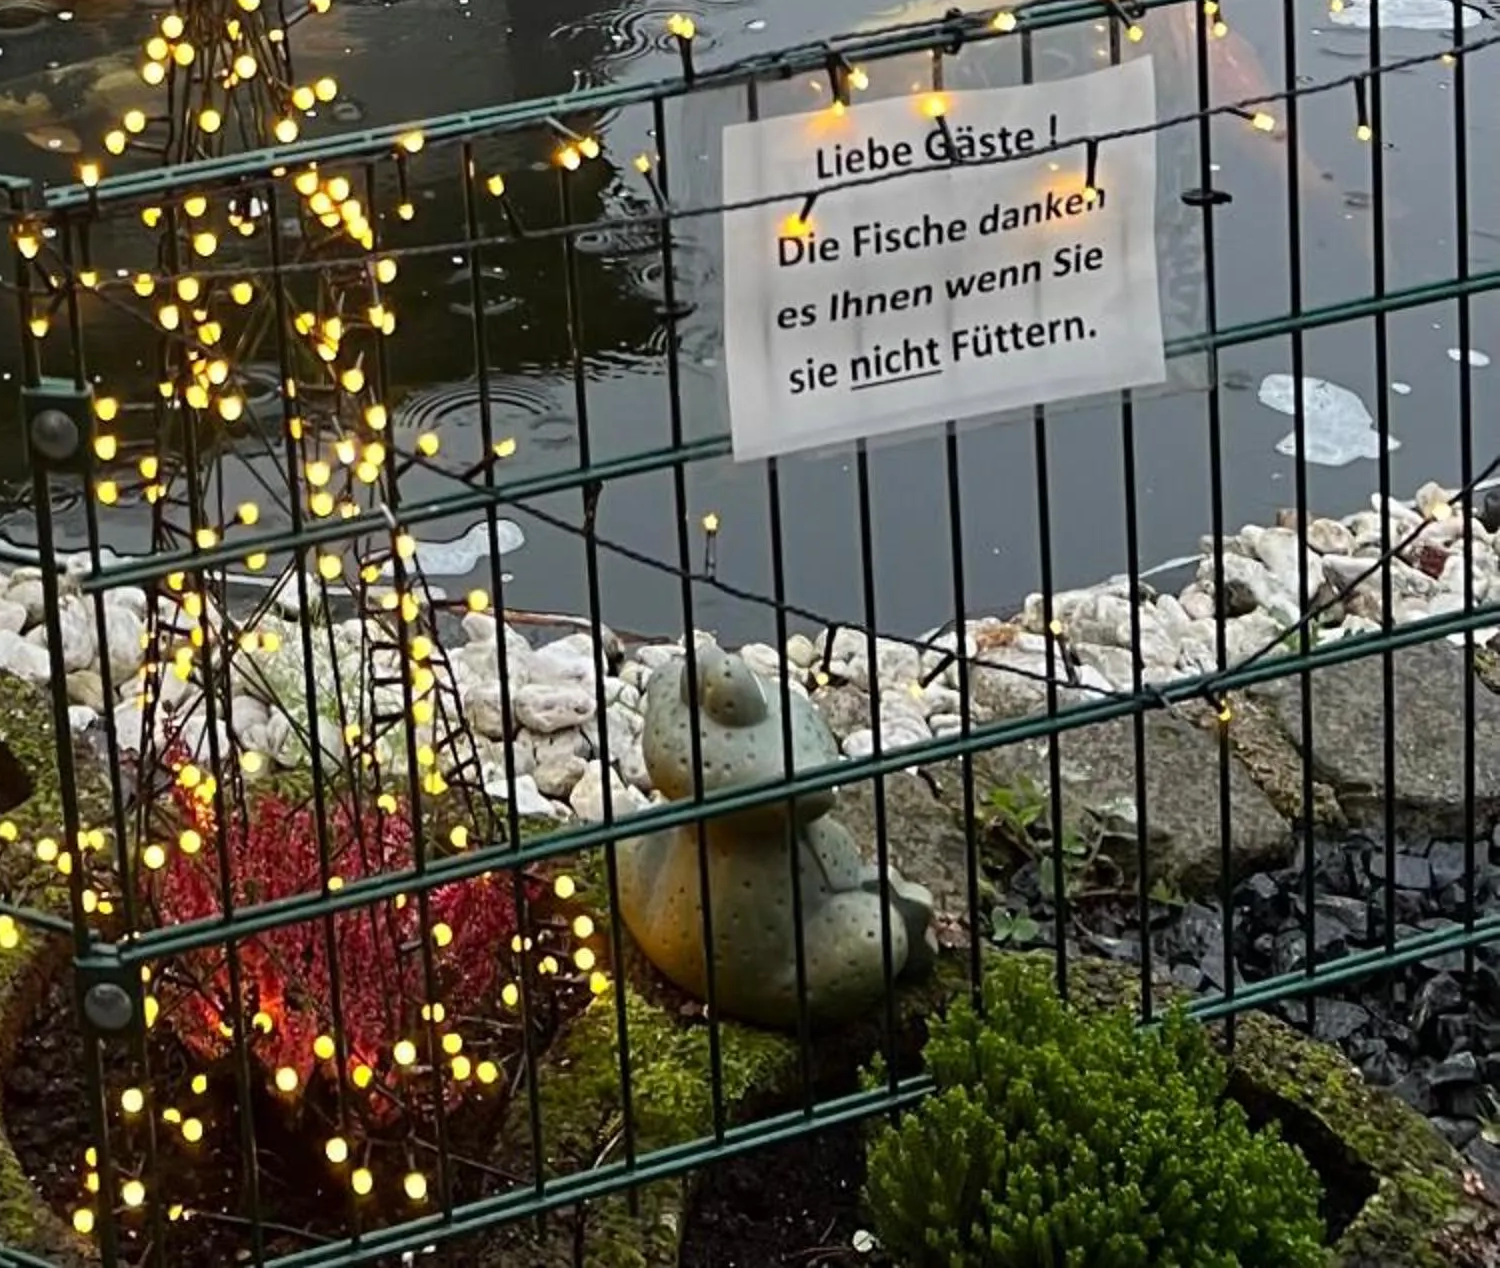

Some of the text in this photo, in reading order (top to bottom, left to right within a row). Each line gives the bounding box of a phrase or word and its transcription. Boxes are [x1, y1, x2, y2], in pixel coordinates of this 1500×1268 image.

[817, 137, 912, 179] Liebe
[925, 125, 1034, 161] Gäste
[778, 188, 1106, 267] Die Fische danken
[777, 244, 1104, 330] es Ihnen wenn Sie
[789, 315, 1097, 395] sie nicht Füttern.
